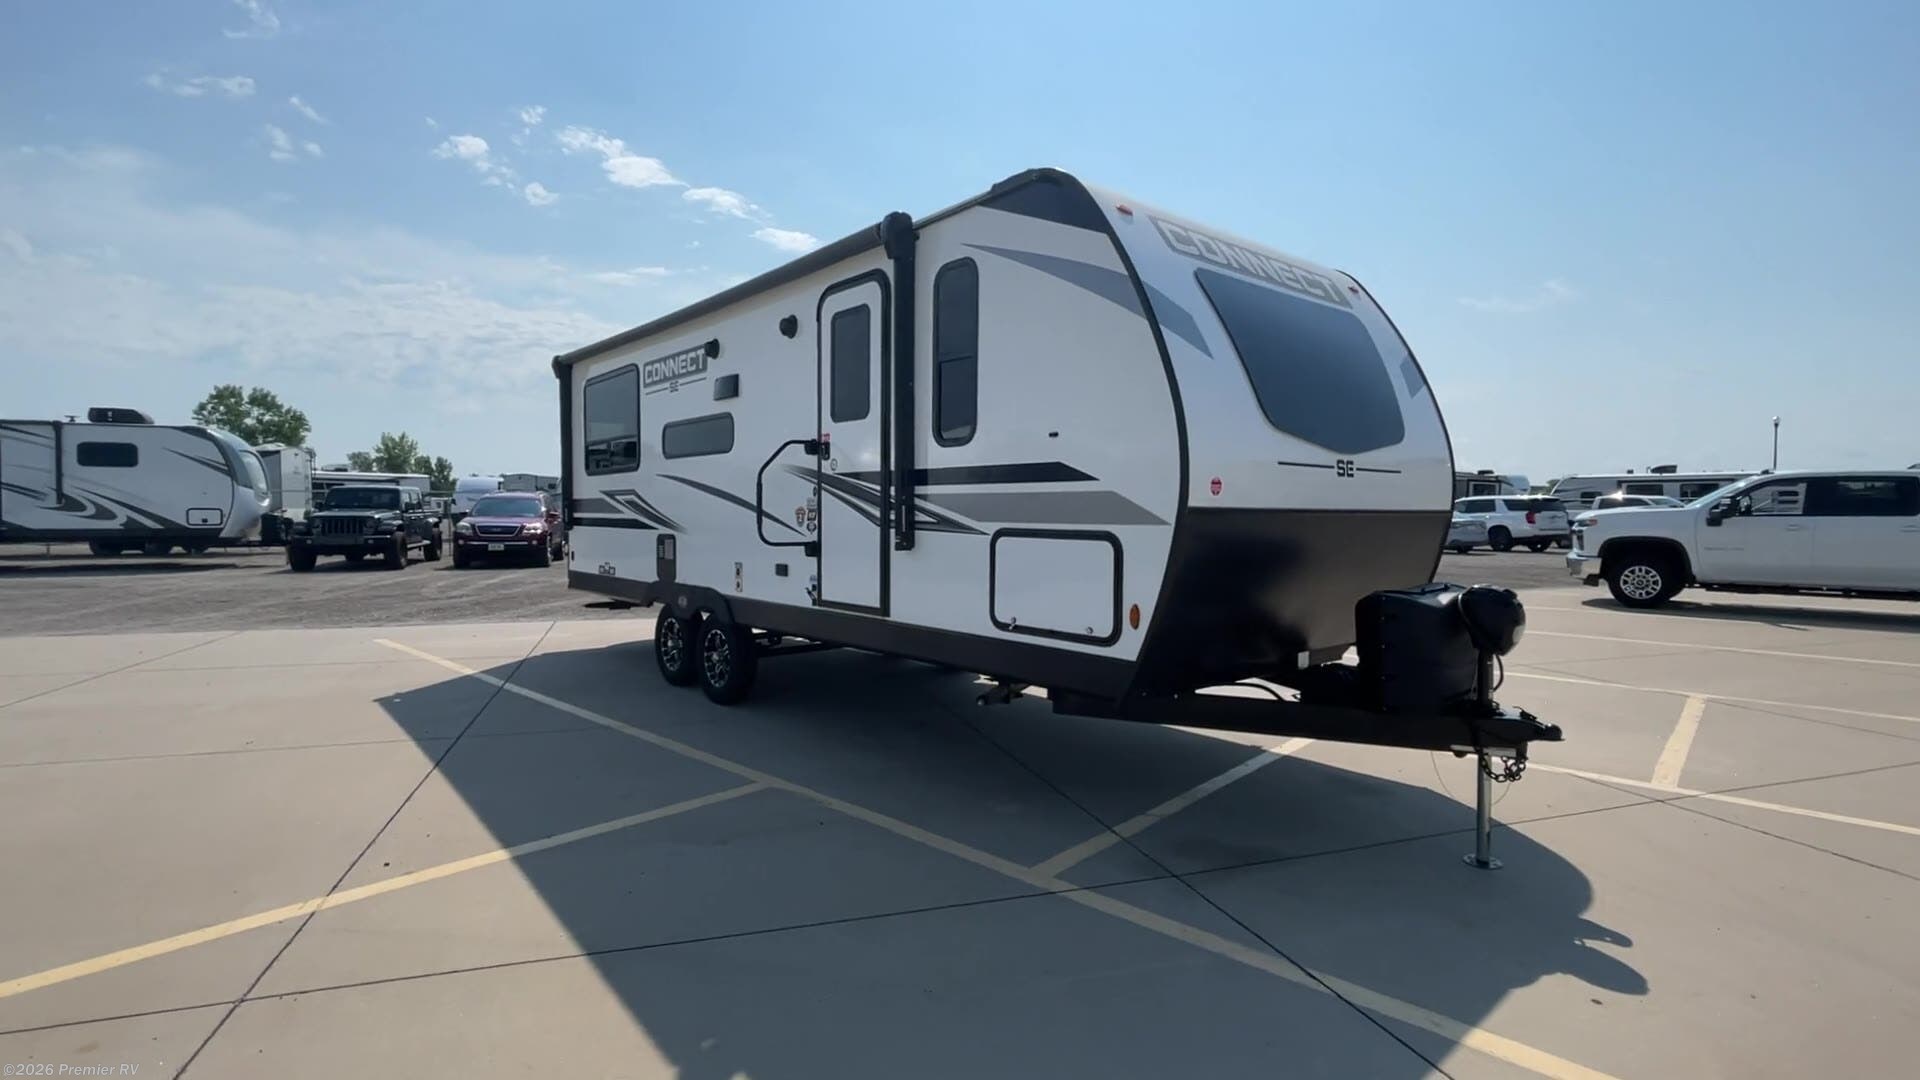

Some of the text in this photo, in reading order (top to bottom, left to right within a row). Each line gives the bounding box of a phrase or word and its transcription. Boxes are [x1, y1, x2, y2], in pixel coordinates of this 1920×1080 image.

[1157, 220, 1340, 301] CONNECT
[645, 349, 704, 384] CONNECT
[1336, 459, 1354, 478] SE
